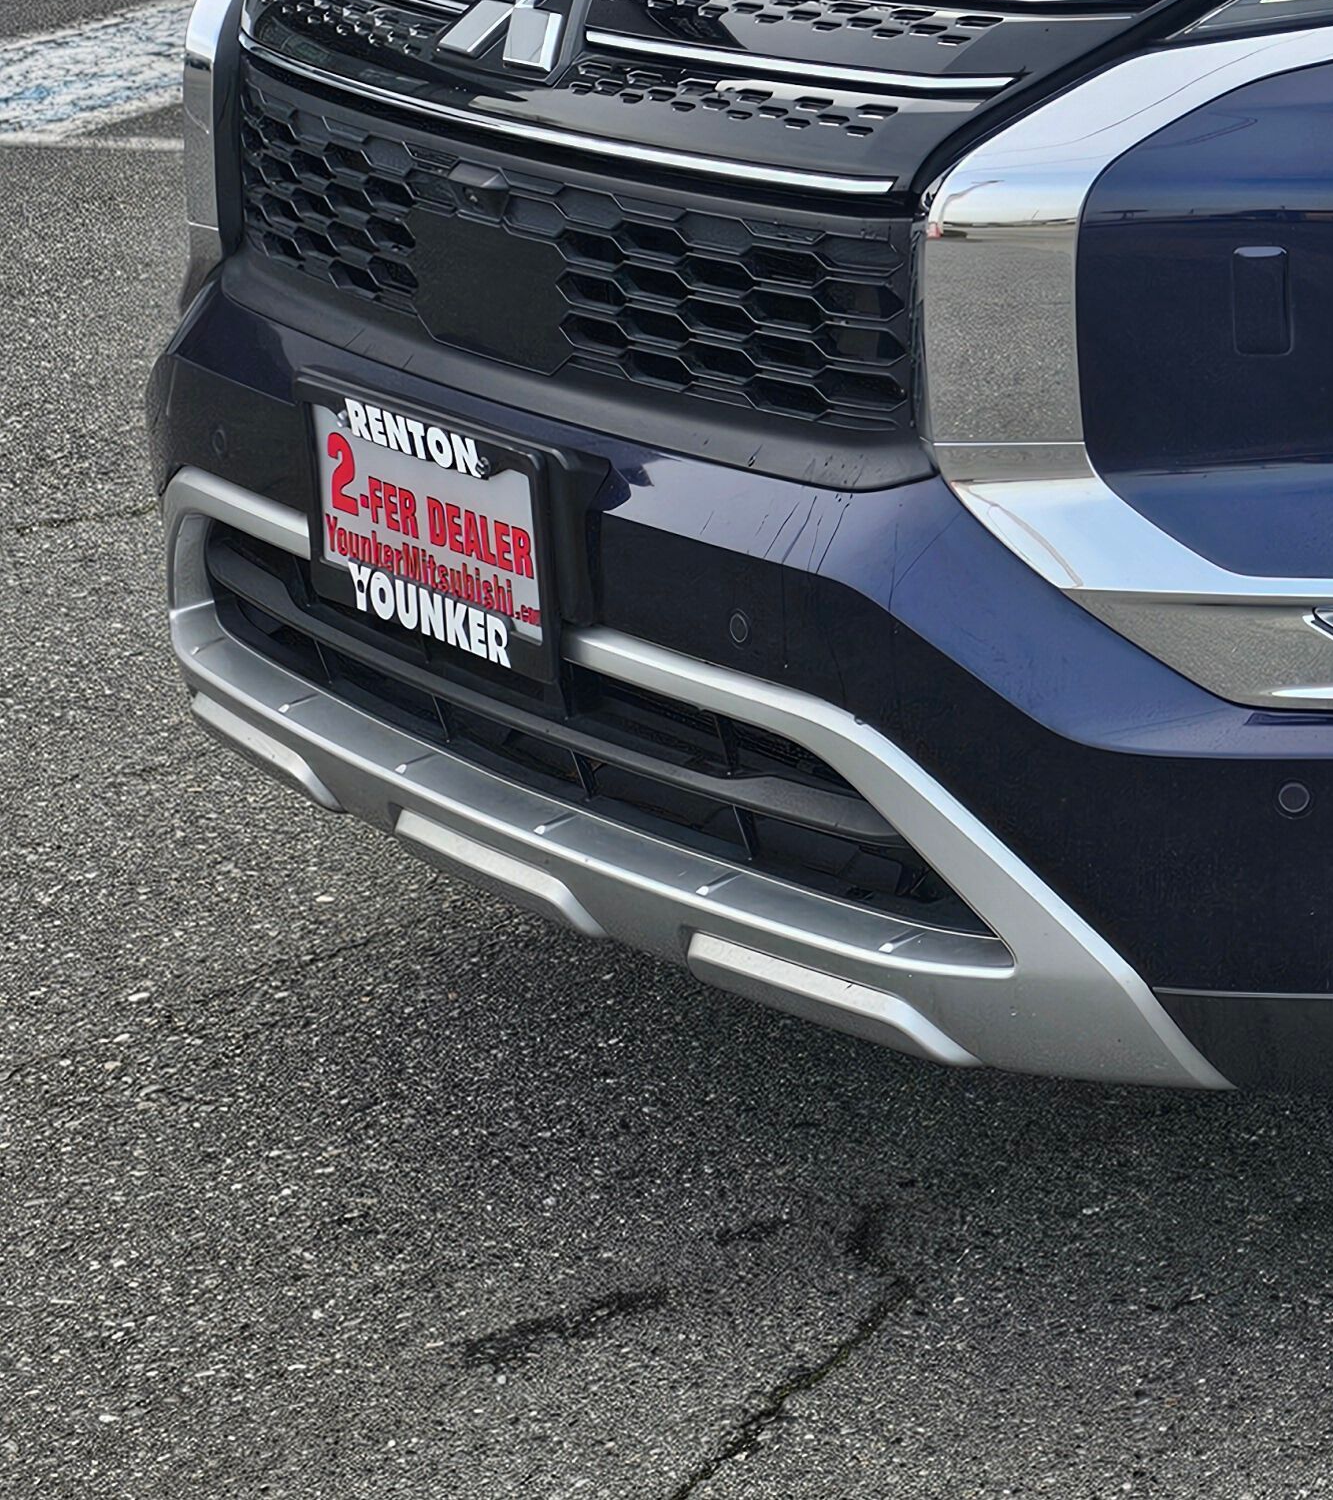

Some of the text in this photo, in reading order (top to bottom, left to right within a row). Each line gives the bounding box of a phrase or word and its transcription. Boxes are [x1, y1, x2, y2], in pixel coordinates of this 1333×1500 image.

[344, 398, 483, 479] RENTON
[327, 432, 534, 579] 2-FER DEALER
[348, 561, 512, 668] YOUNKER
